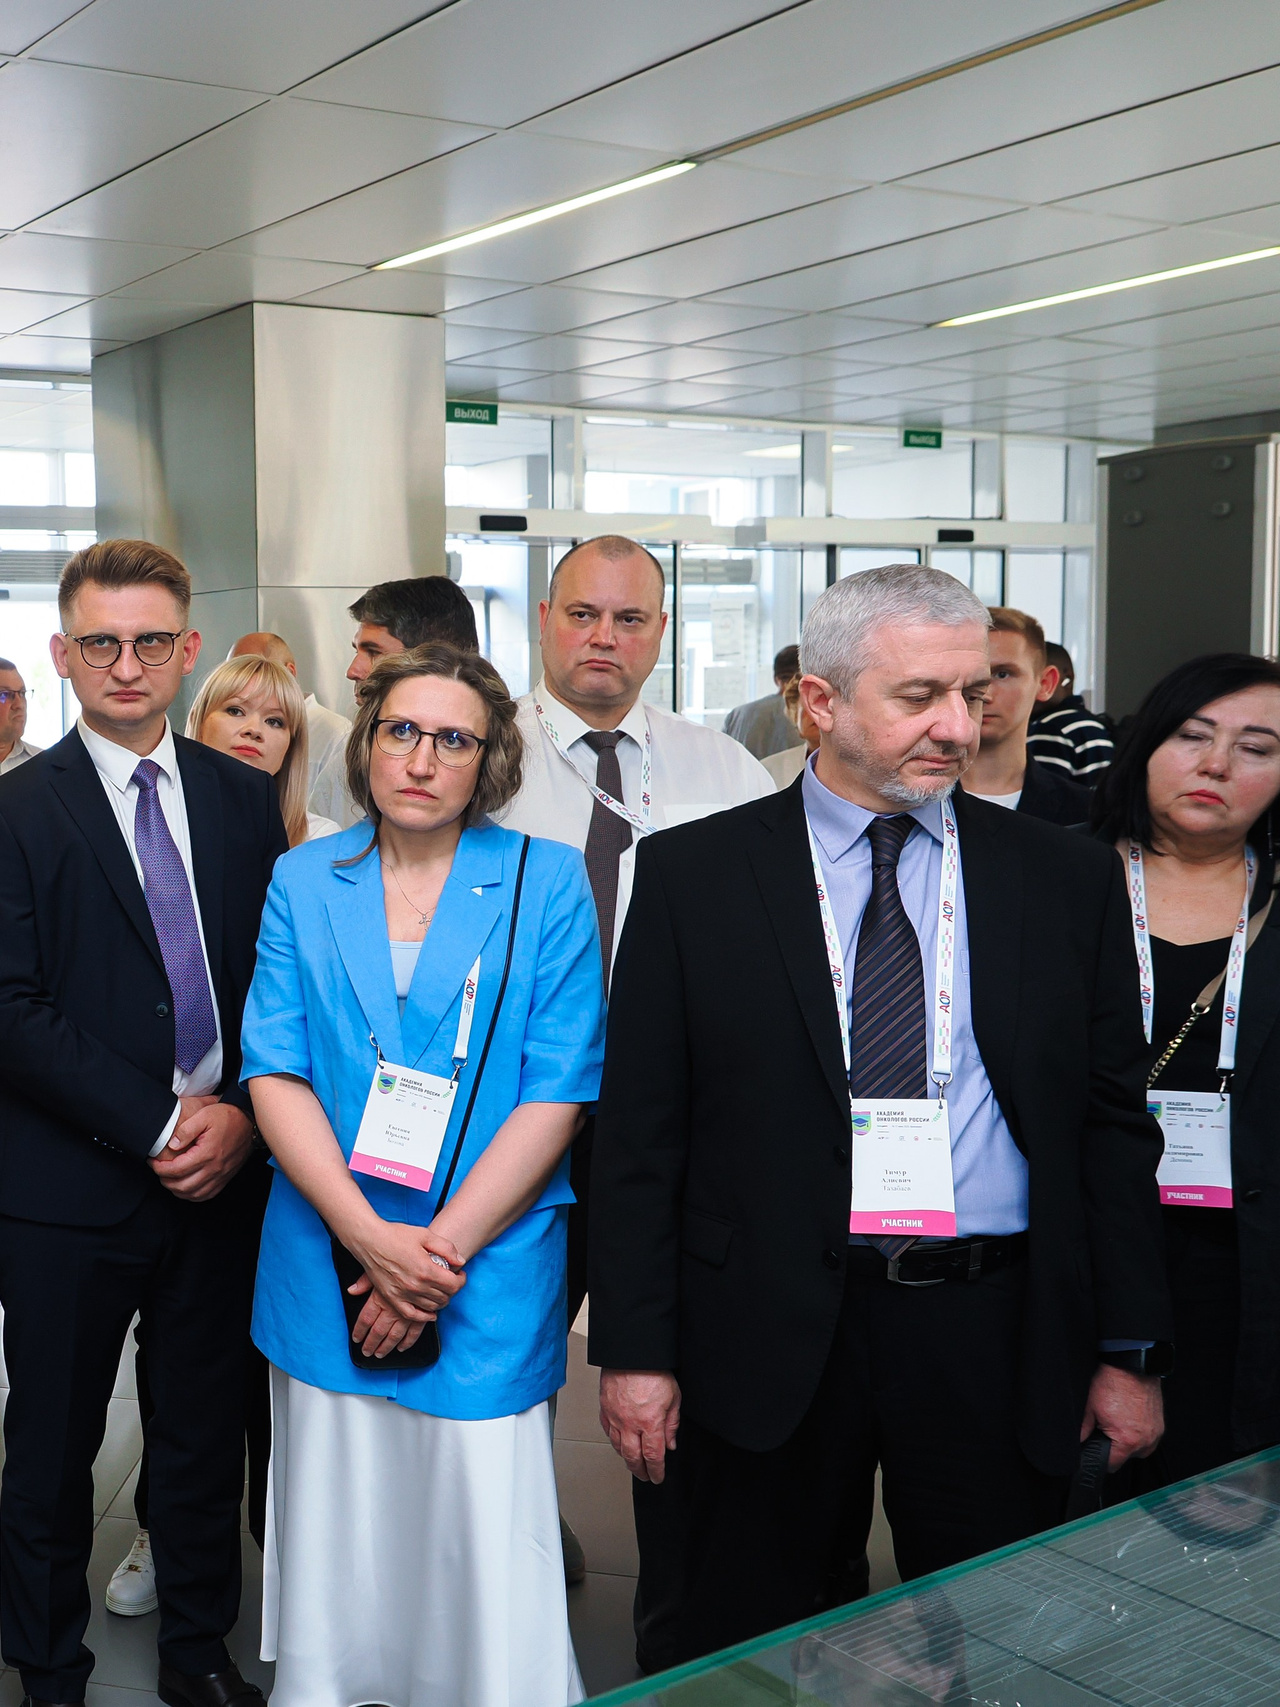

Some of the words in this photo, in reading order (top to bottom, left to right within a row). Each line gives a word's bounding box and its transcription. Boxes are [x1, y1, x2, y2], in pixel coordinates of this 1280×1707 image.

[454, 407, 489, 421] ВЫХОД
[945, 818, 956, 838] АОР
[1130, 846, 1140, 863] АОР
[942, 900, 954, 923] АОР
[1134, 913, 1146, 931] АОР
[830, 964, 842, 988] АОР
[465, 978, 476, 1000] АОР
[1140, 984, 1151, 1005] АОР
[939, 990, 951, 1014] АОР
[1224, 1005, 1236, 1027] АОР
[374, 1163, 407, 1179] УЧАСТНИК
[1166, 1191, 1204, 1201] УЧАСТНИК
[881, 1218, 923, 1228] УЧАСТНИК
